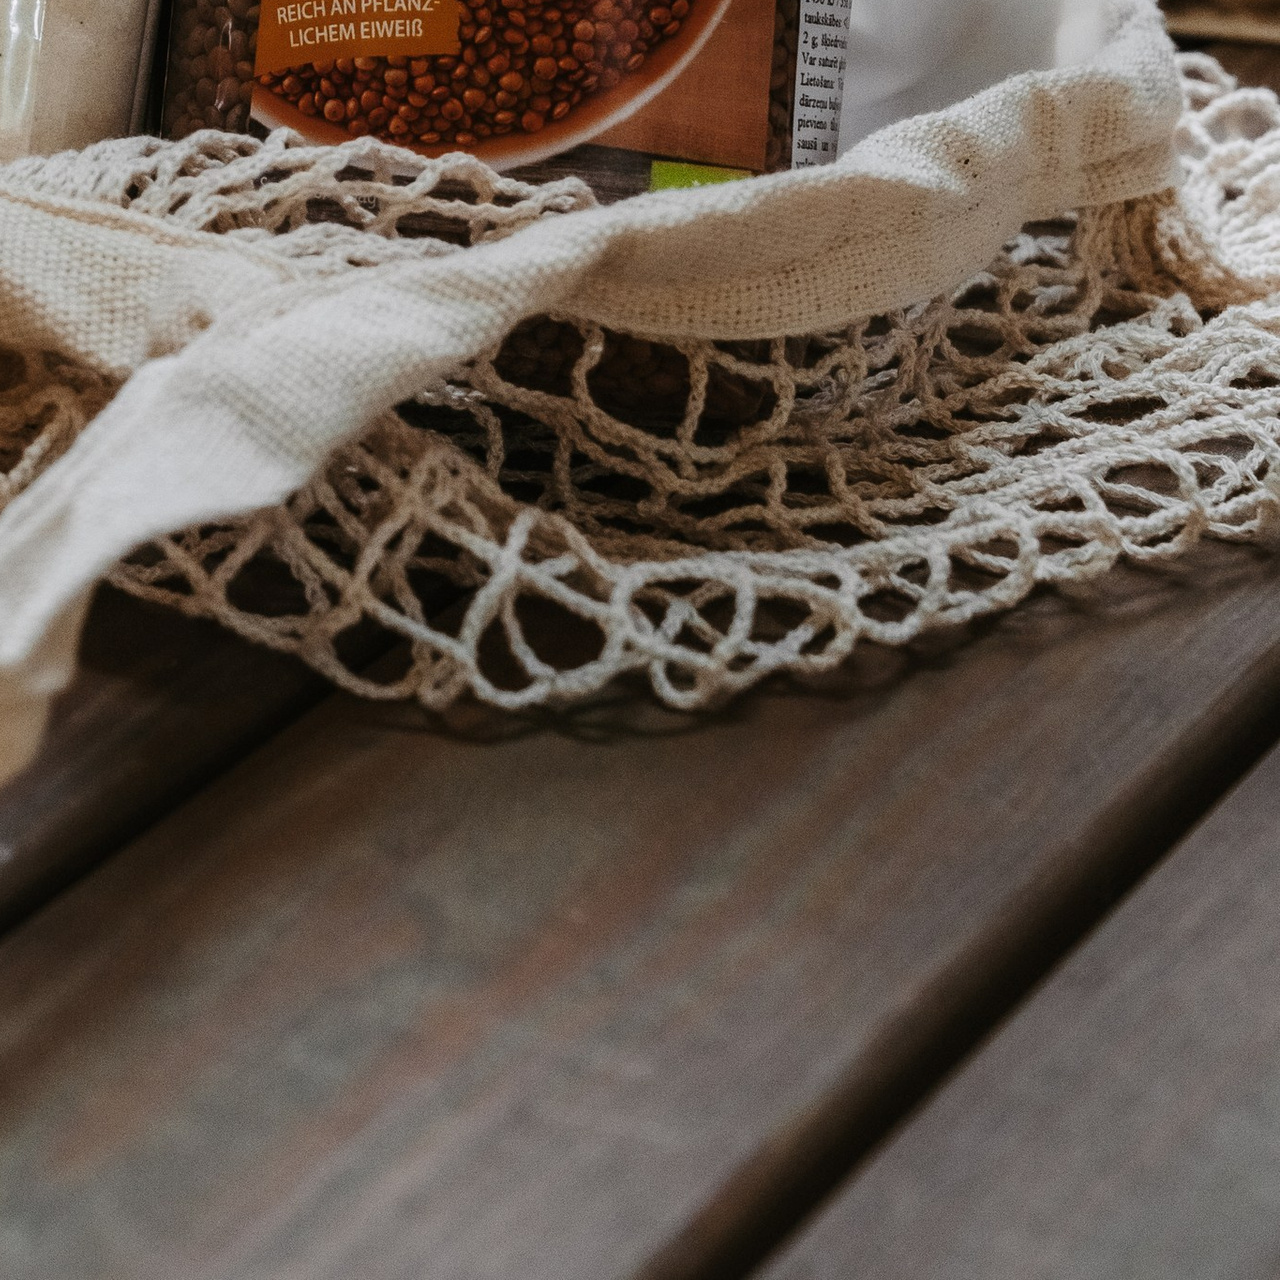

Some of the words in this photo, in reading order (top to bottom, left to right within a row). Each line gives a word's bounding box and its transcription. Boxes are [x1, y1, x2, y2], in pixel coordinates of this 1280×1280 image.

[276, 0, 326, 25] REICH
[289, 22, 356, 49] LICHEM
[360, 18, 424, 40] EIWEIß
[803, 30, 809, 44] 2
[802, 51, 817, 66] Var
